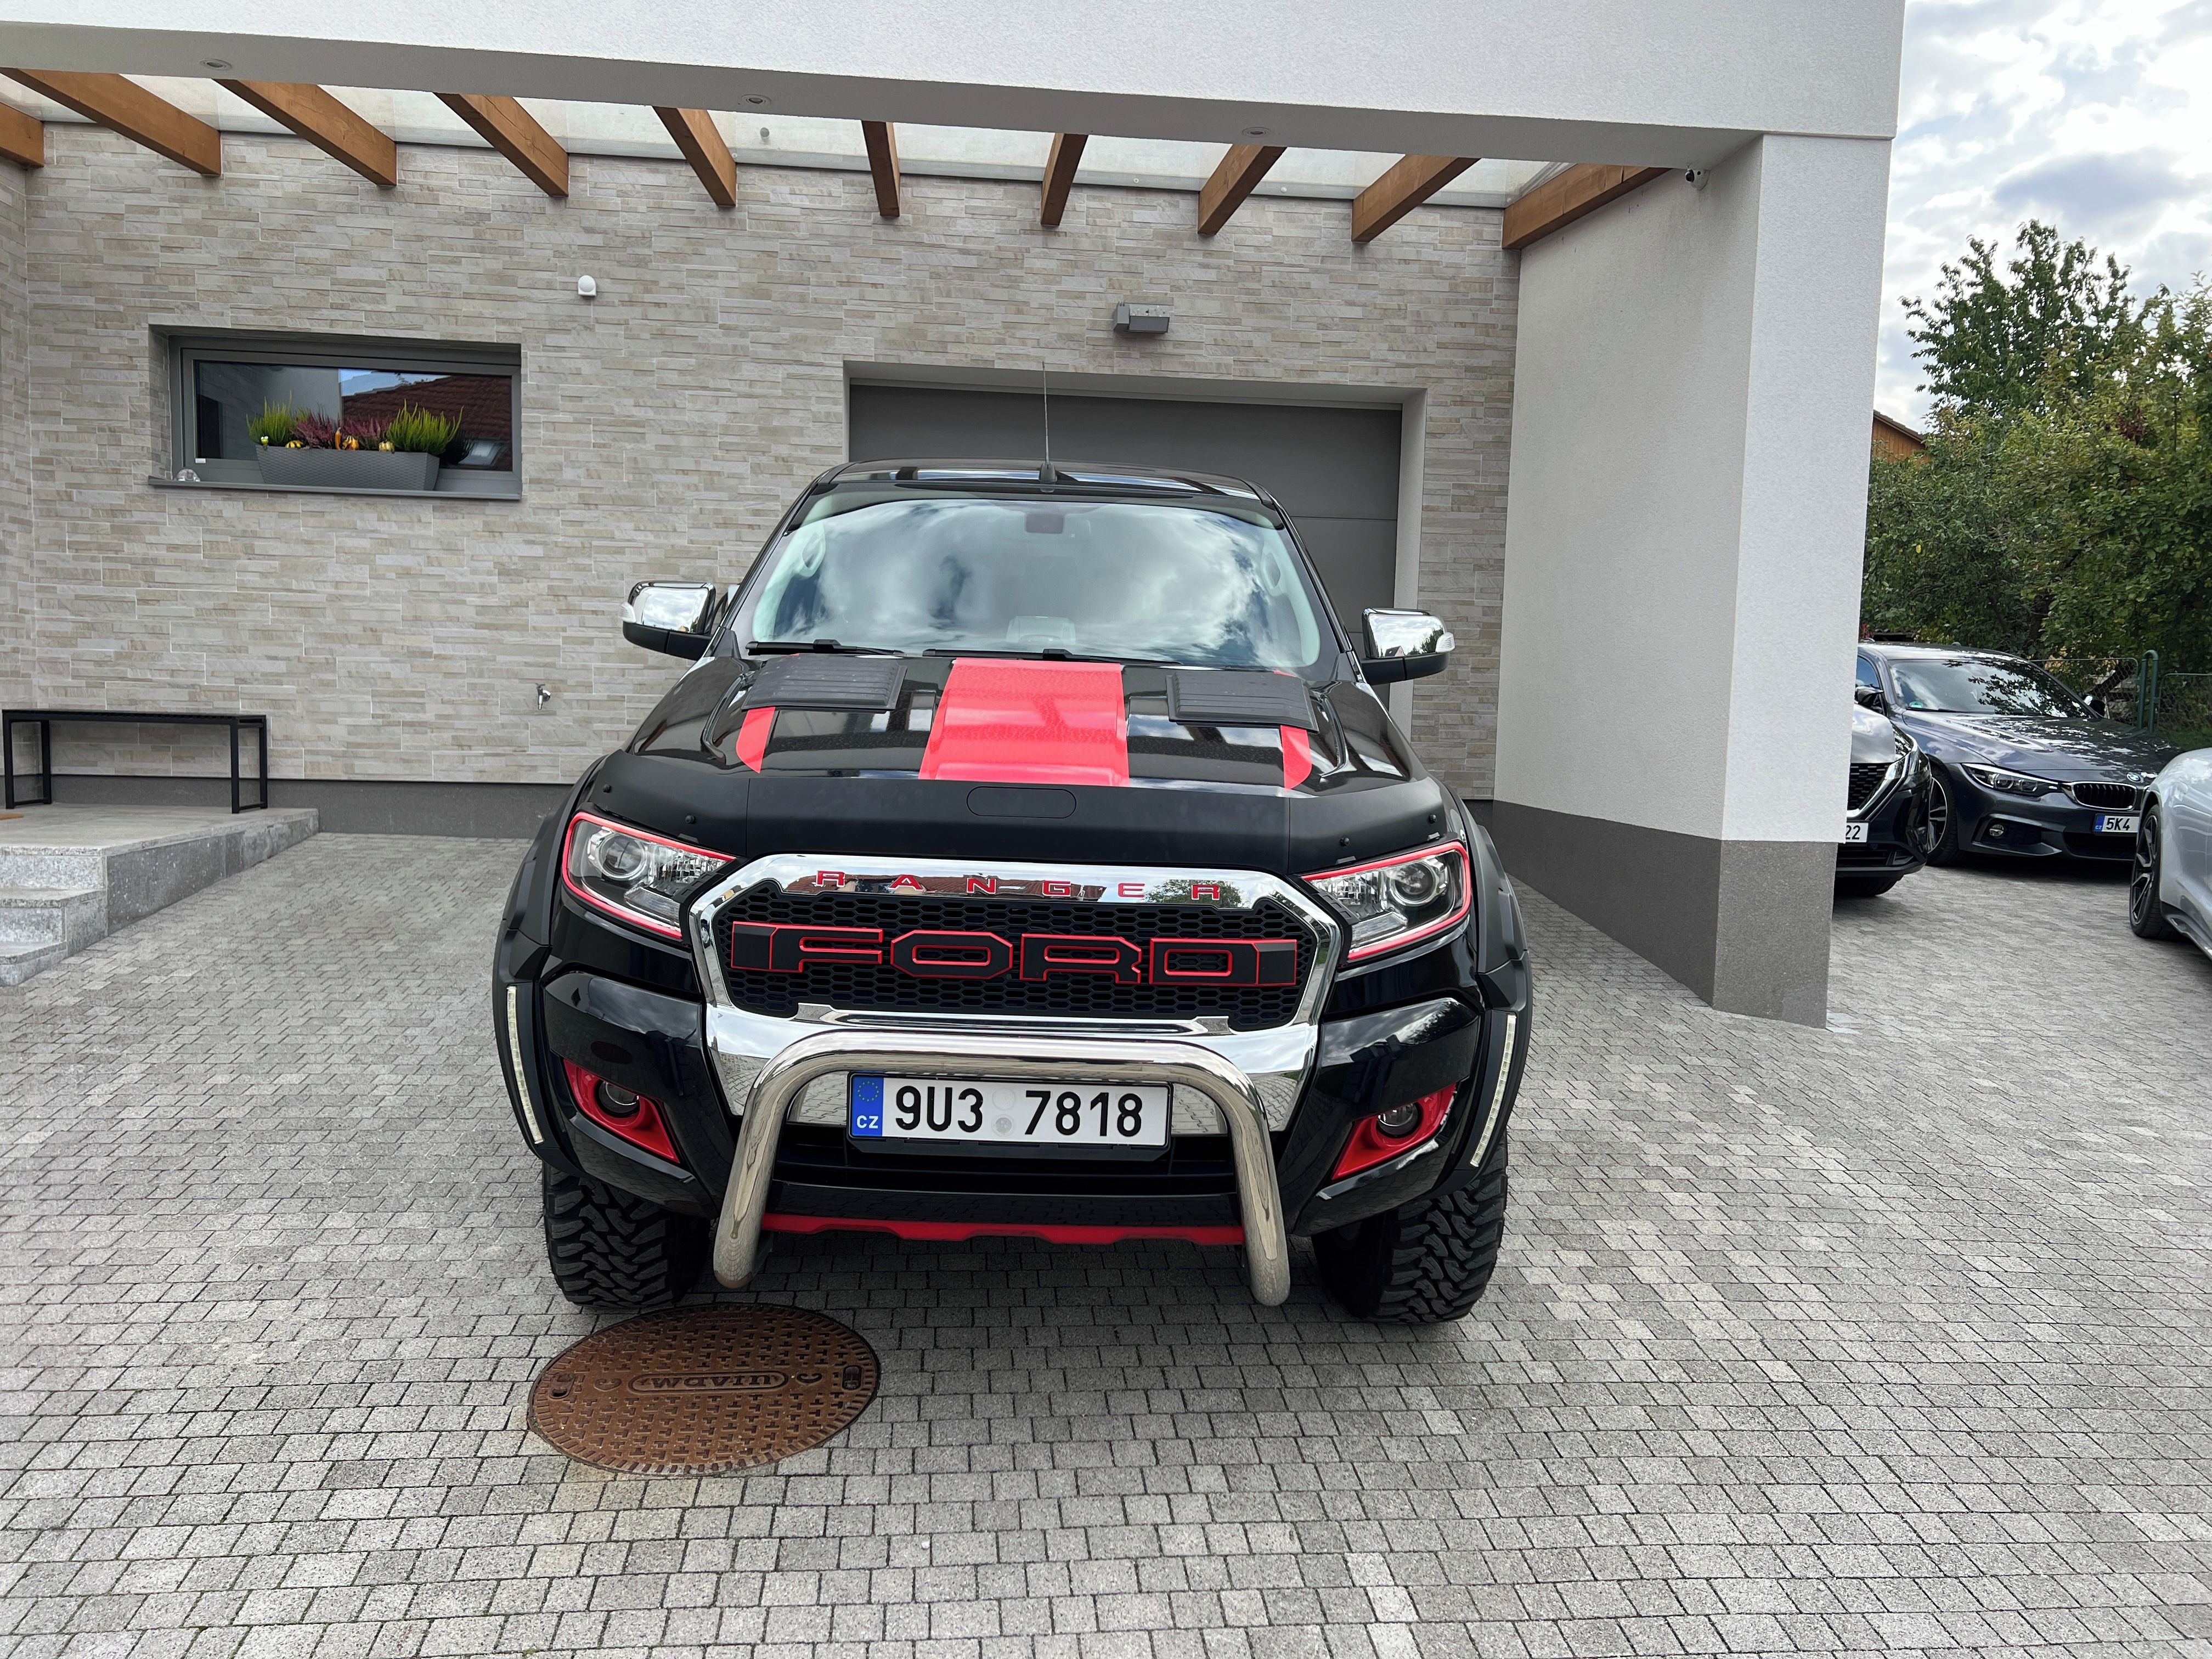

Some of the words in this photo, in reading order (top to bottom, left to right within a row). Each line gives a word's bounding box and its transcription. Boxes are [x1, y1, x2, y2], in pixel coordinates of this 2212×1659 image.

[1846, 825, 1861, 840] 22
[2106, 817, 2130, 831] 5K4
[816, 870, 1220, 901] RANGER
[731, 921, 1298, 985] FORD
[856, 1115, 879, 1129] CZ
[895, 1085, 983, 1133] 9U3
[1024, 1090, 1143, 1137] 7818
